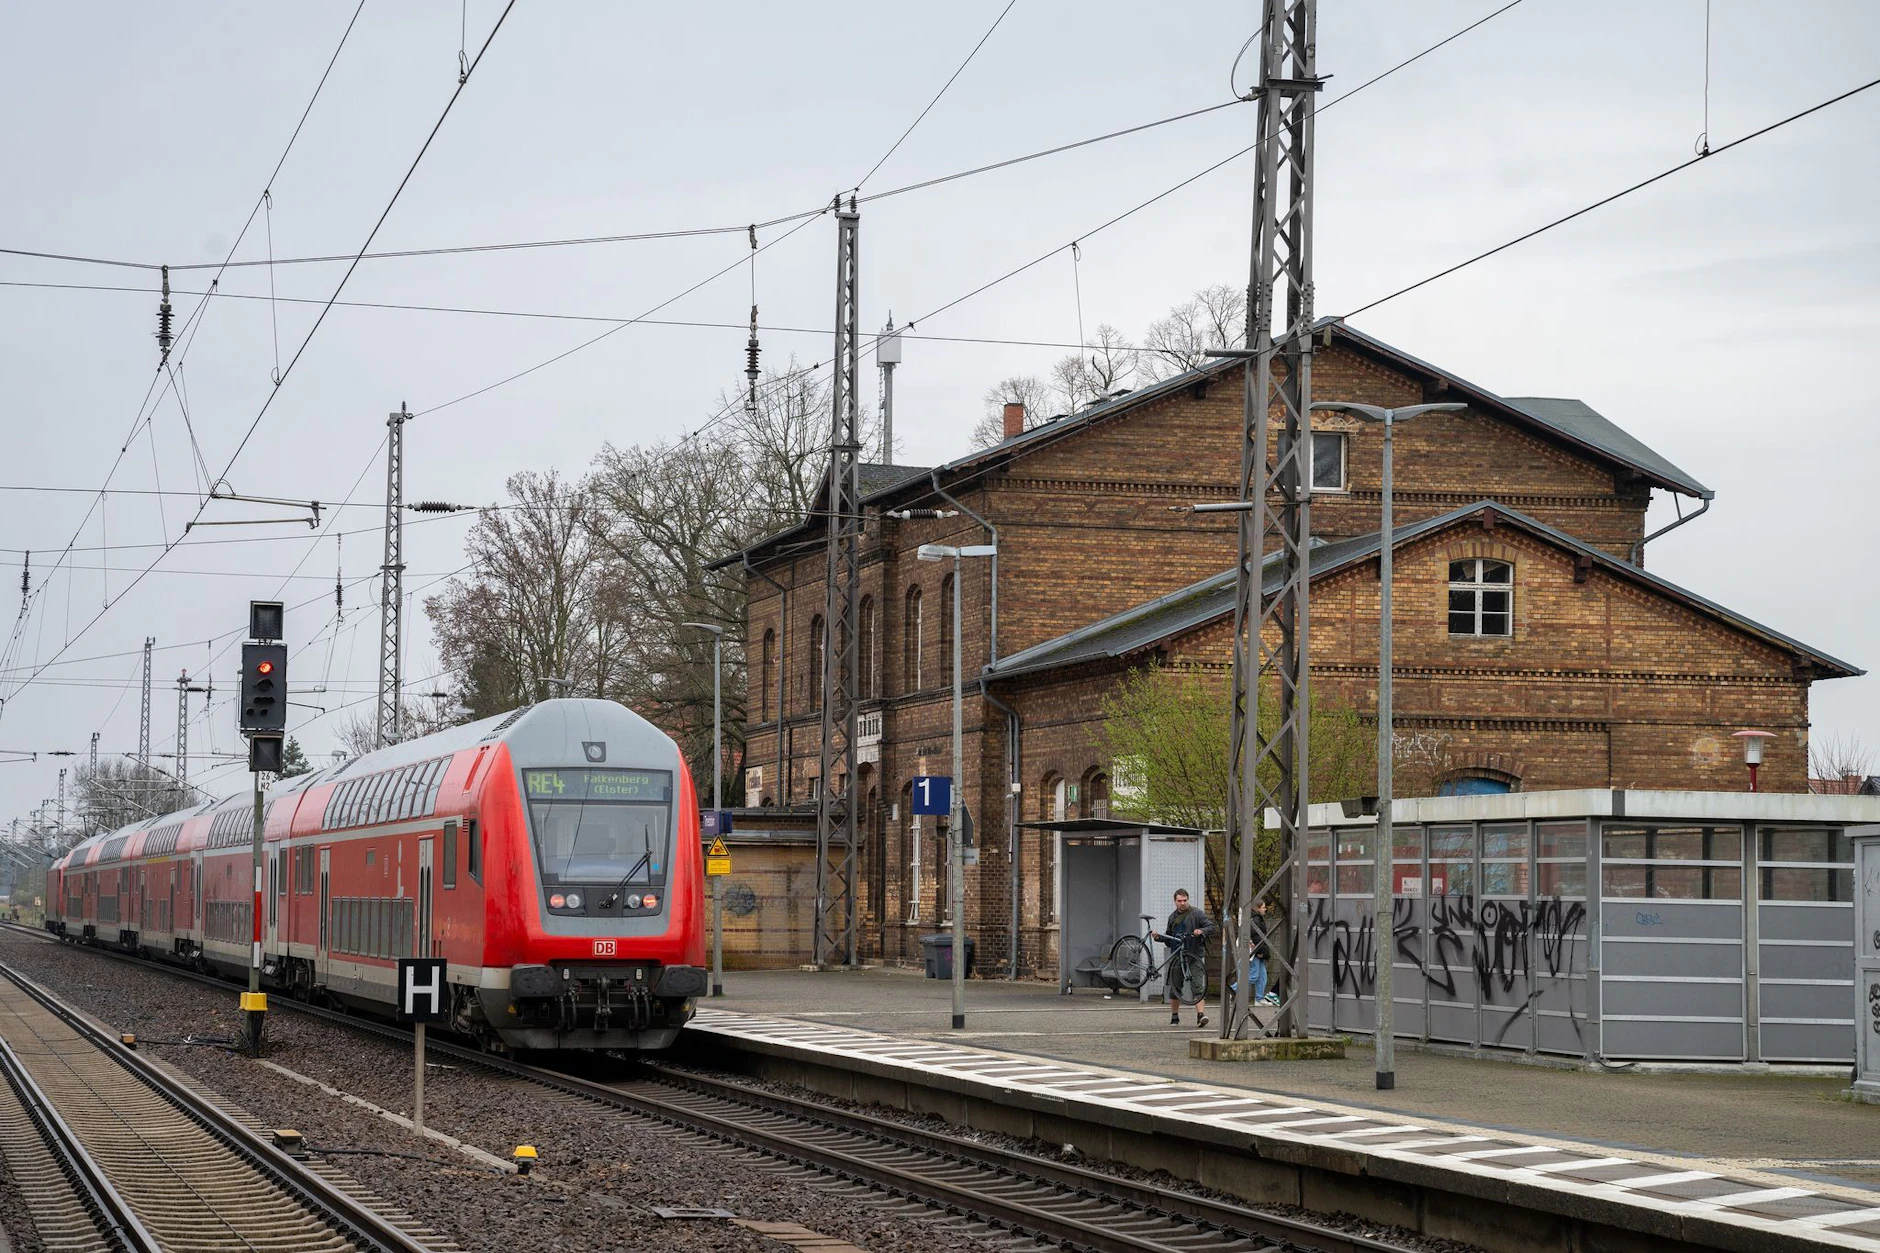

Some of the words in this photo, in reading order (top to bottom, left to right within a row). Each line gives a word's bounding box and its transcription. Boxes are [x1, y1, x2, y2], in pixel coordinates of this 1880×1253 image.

[528, 773, 566, 794] RE4
[584, 774, 649, 785] Falkenberg
[594, 785, 639, 794] (Elster)
[918, 778, 930, 806] 1
[596, 942, 614, 954] DB
[405, 966, 440, 1014] H
